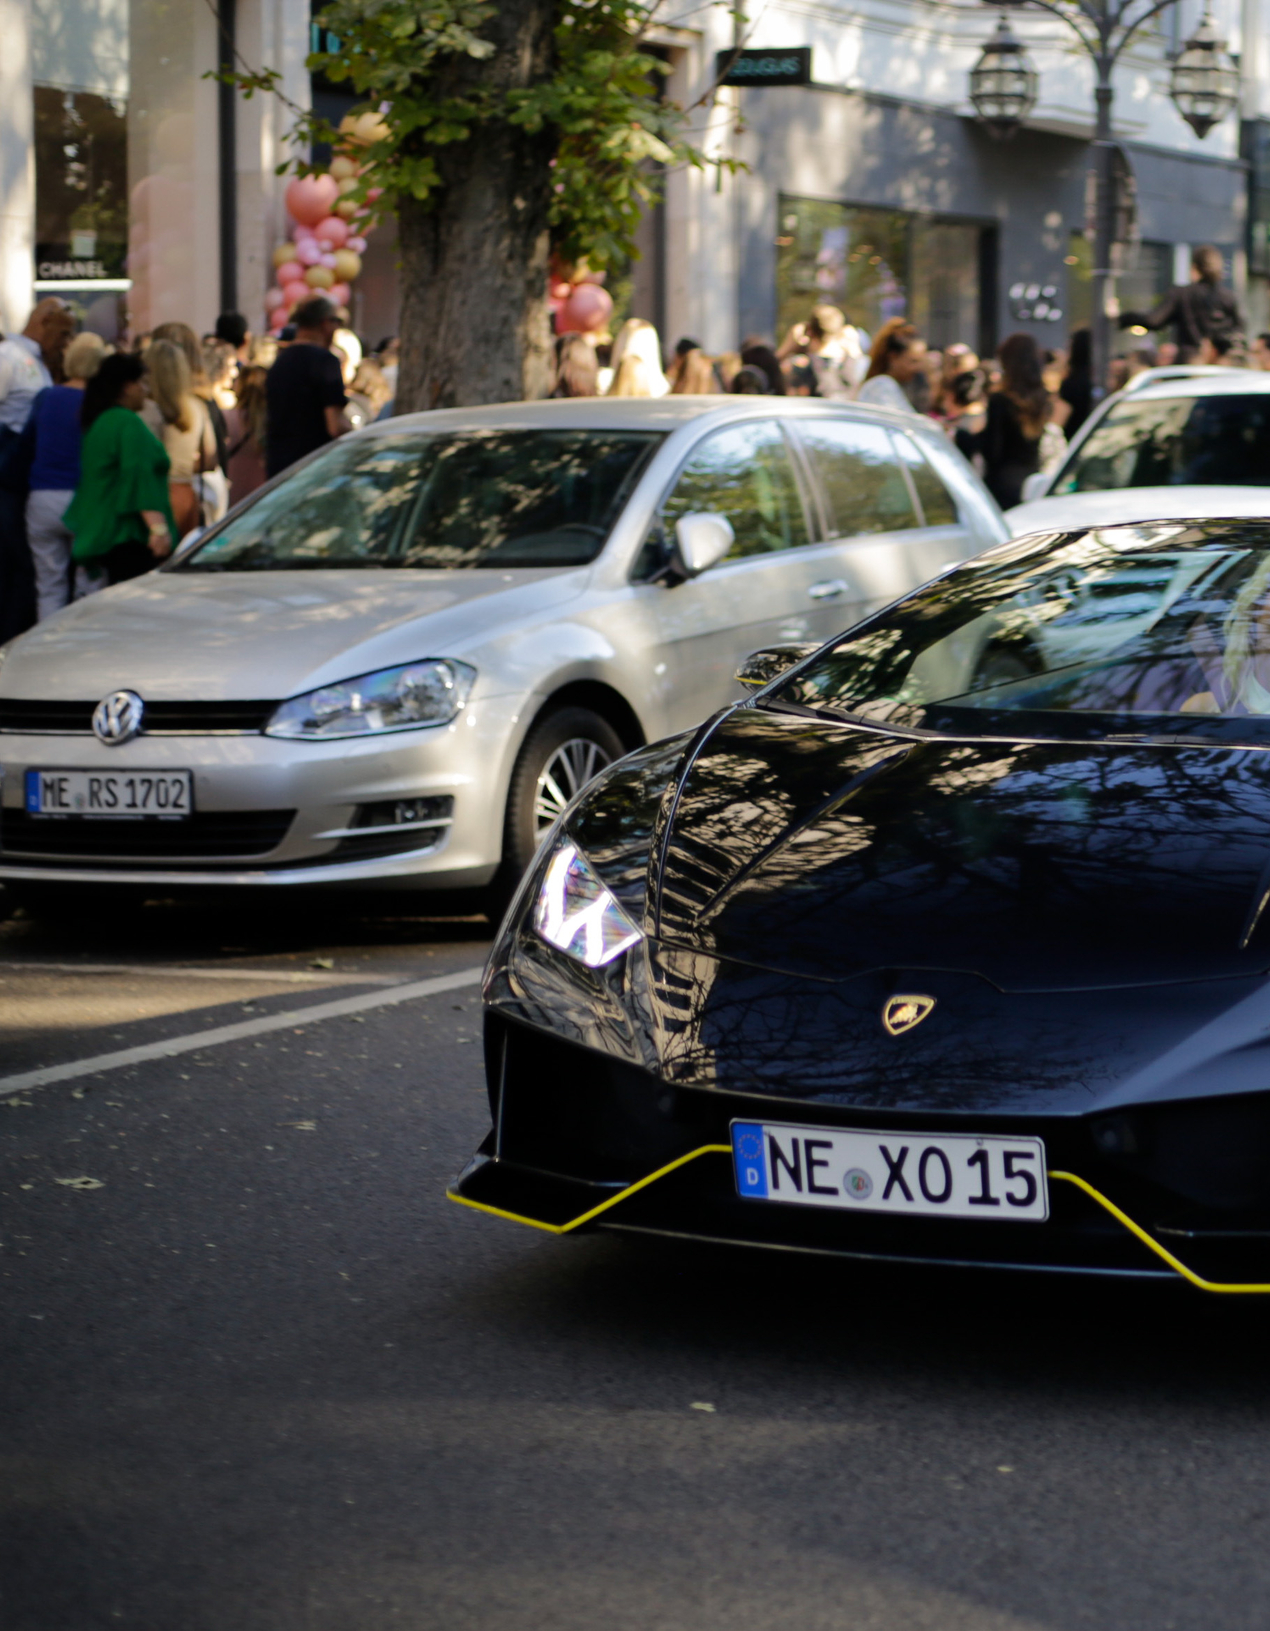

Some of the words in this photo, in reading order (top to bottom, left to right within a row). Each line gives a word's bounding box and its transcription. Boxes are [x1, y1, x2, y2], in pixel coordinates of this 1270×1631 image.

[39, 261, 108, 278] CHANEL
[42, 777, 71, 808] ME
[88, 777, 119, 808] RS
[124, 778, 185, 809] 1702
[747, 1167, 760, 1186] D
[768, 1134, 839, 1196] NE
[878, 1144, 953, 1204] XO
[966, 1148, 1038, 1207] 15
